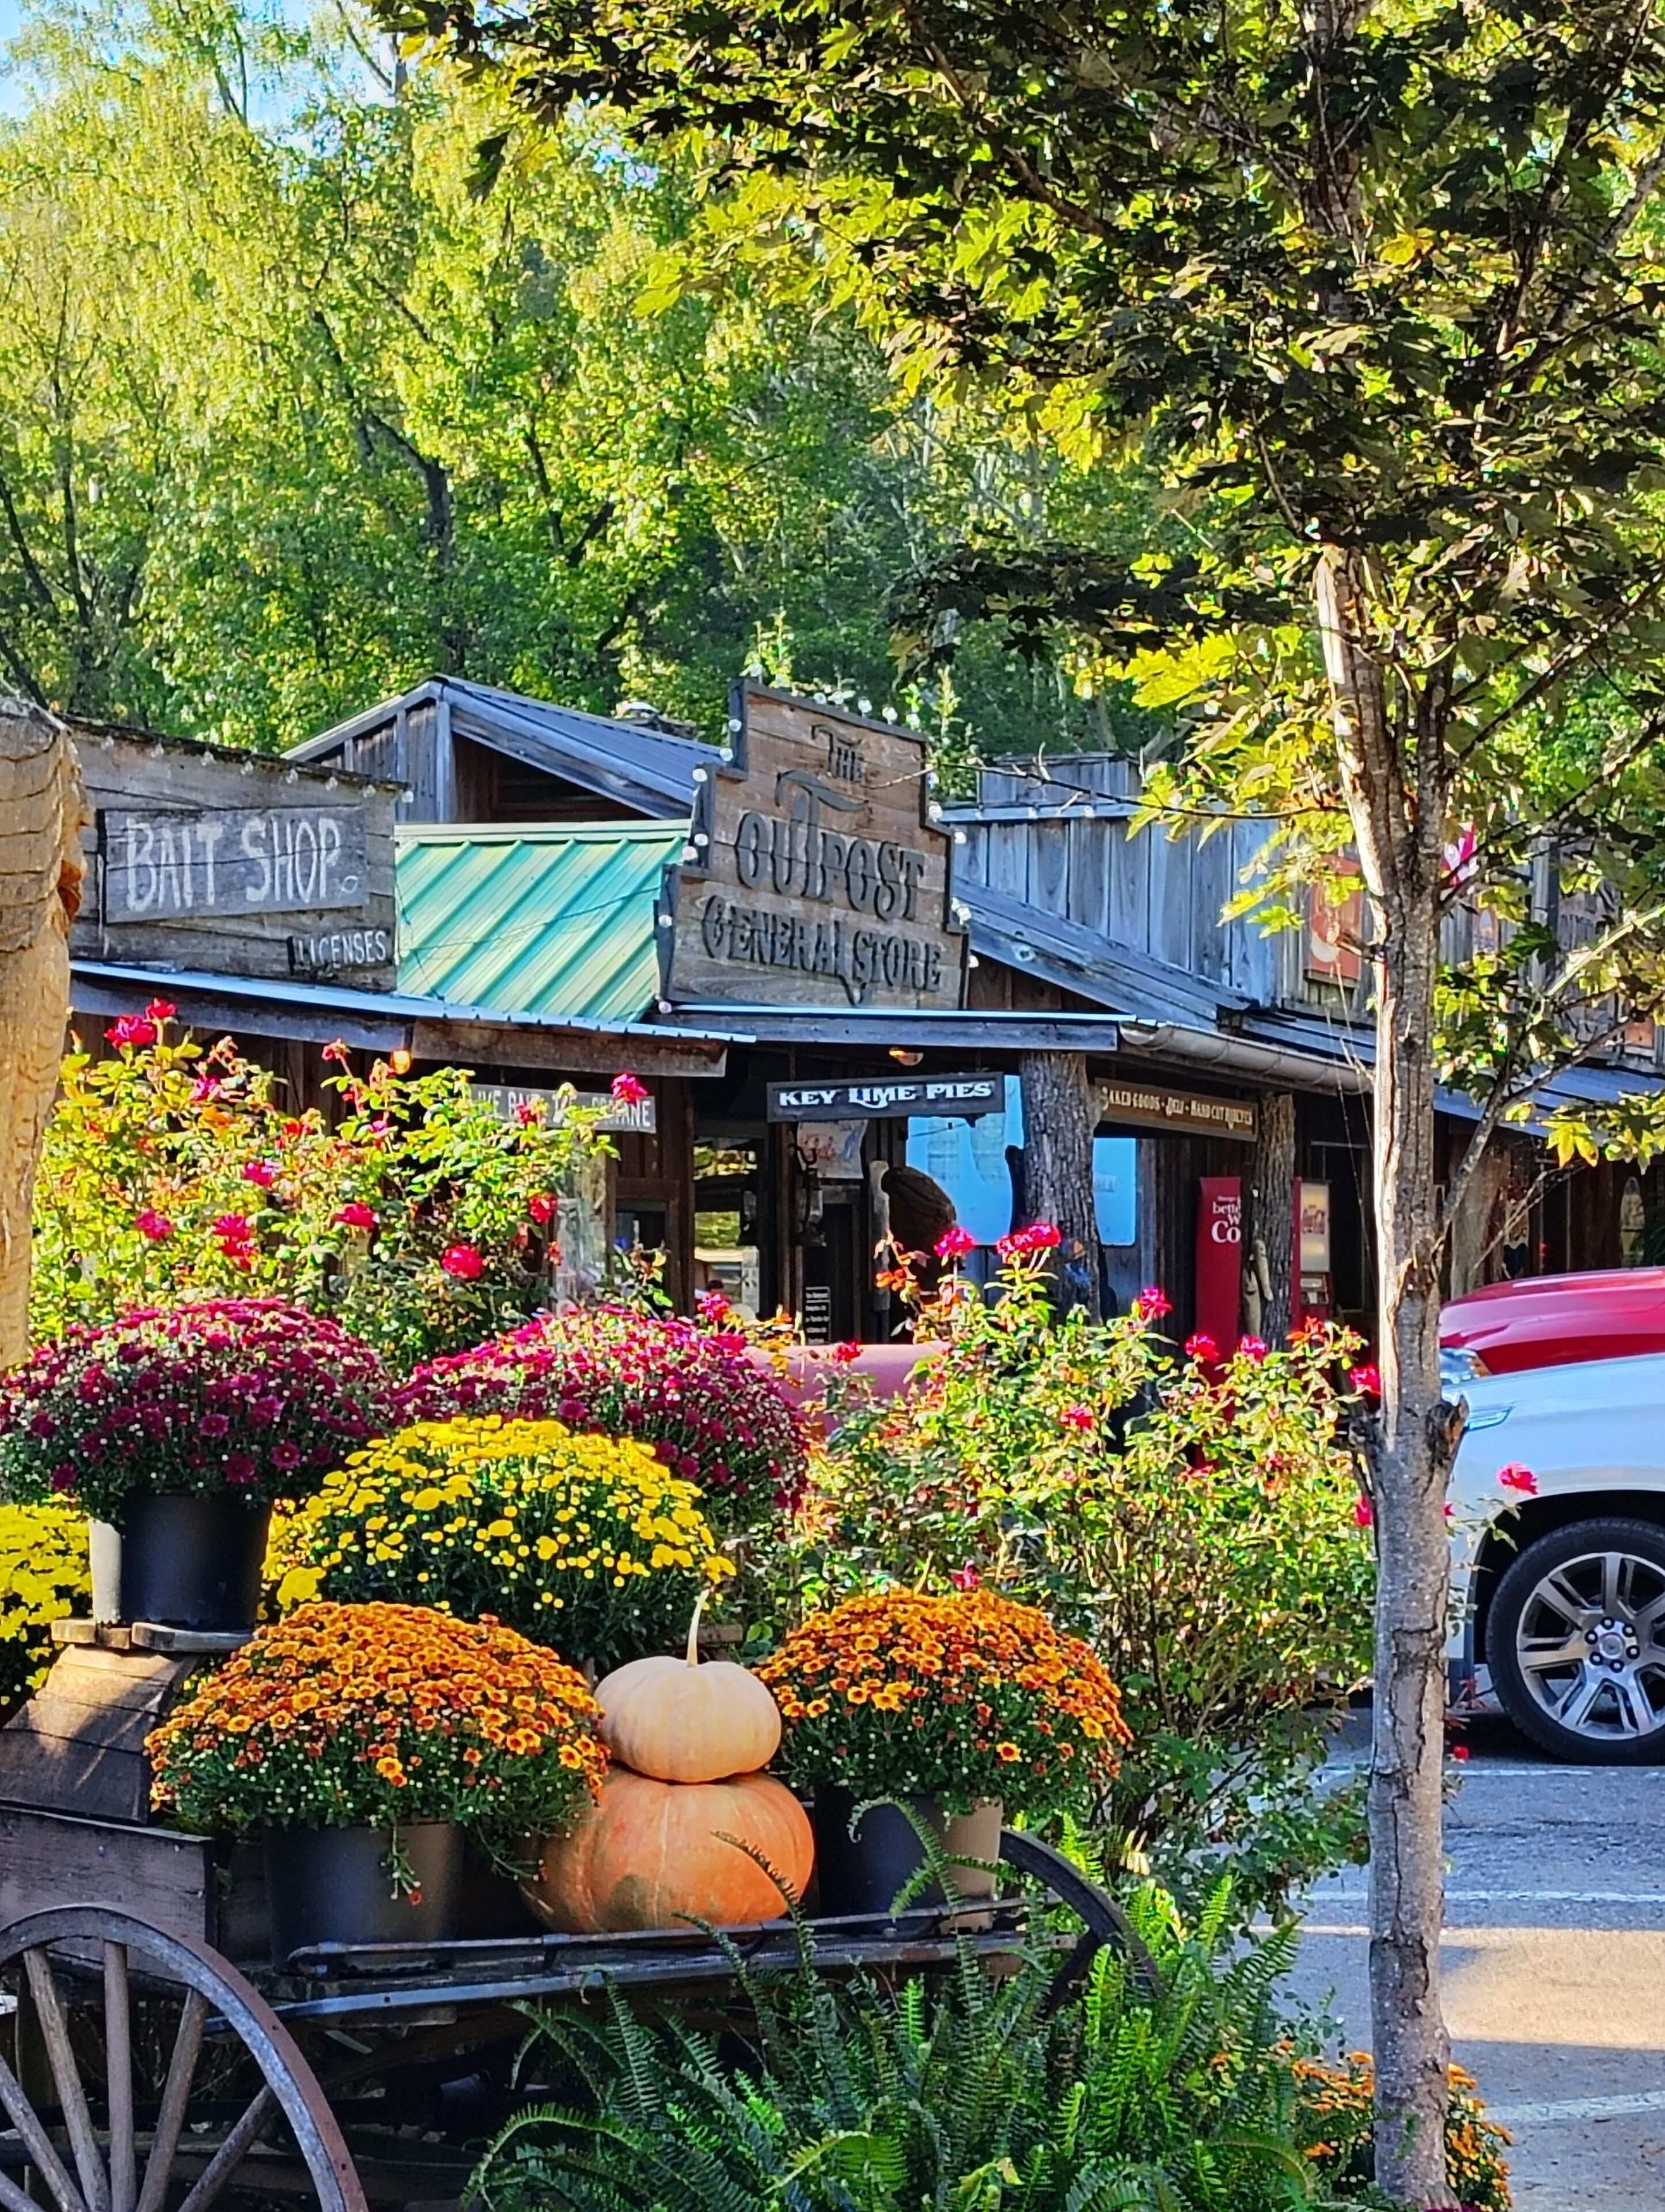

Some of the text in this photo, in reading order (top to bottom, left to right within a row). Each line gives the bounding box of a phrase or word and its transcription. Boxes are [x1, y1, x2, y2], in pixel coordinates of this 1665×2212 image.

[126, 816, 342, 912] BAIT SHOP
[734, 770, 924, 921] OUTPOST
[294, 930, 387, 971] LICENSES
[701, 895, 942, 1006] GENERAL STORE
[779, 1082, 992, 1109] KEY LIME PIES
[1132, 1093, 1160, 1111] GOODS
[1165, 1096, 1184, 1116] DELI
